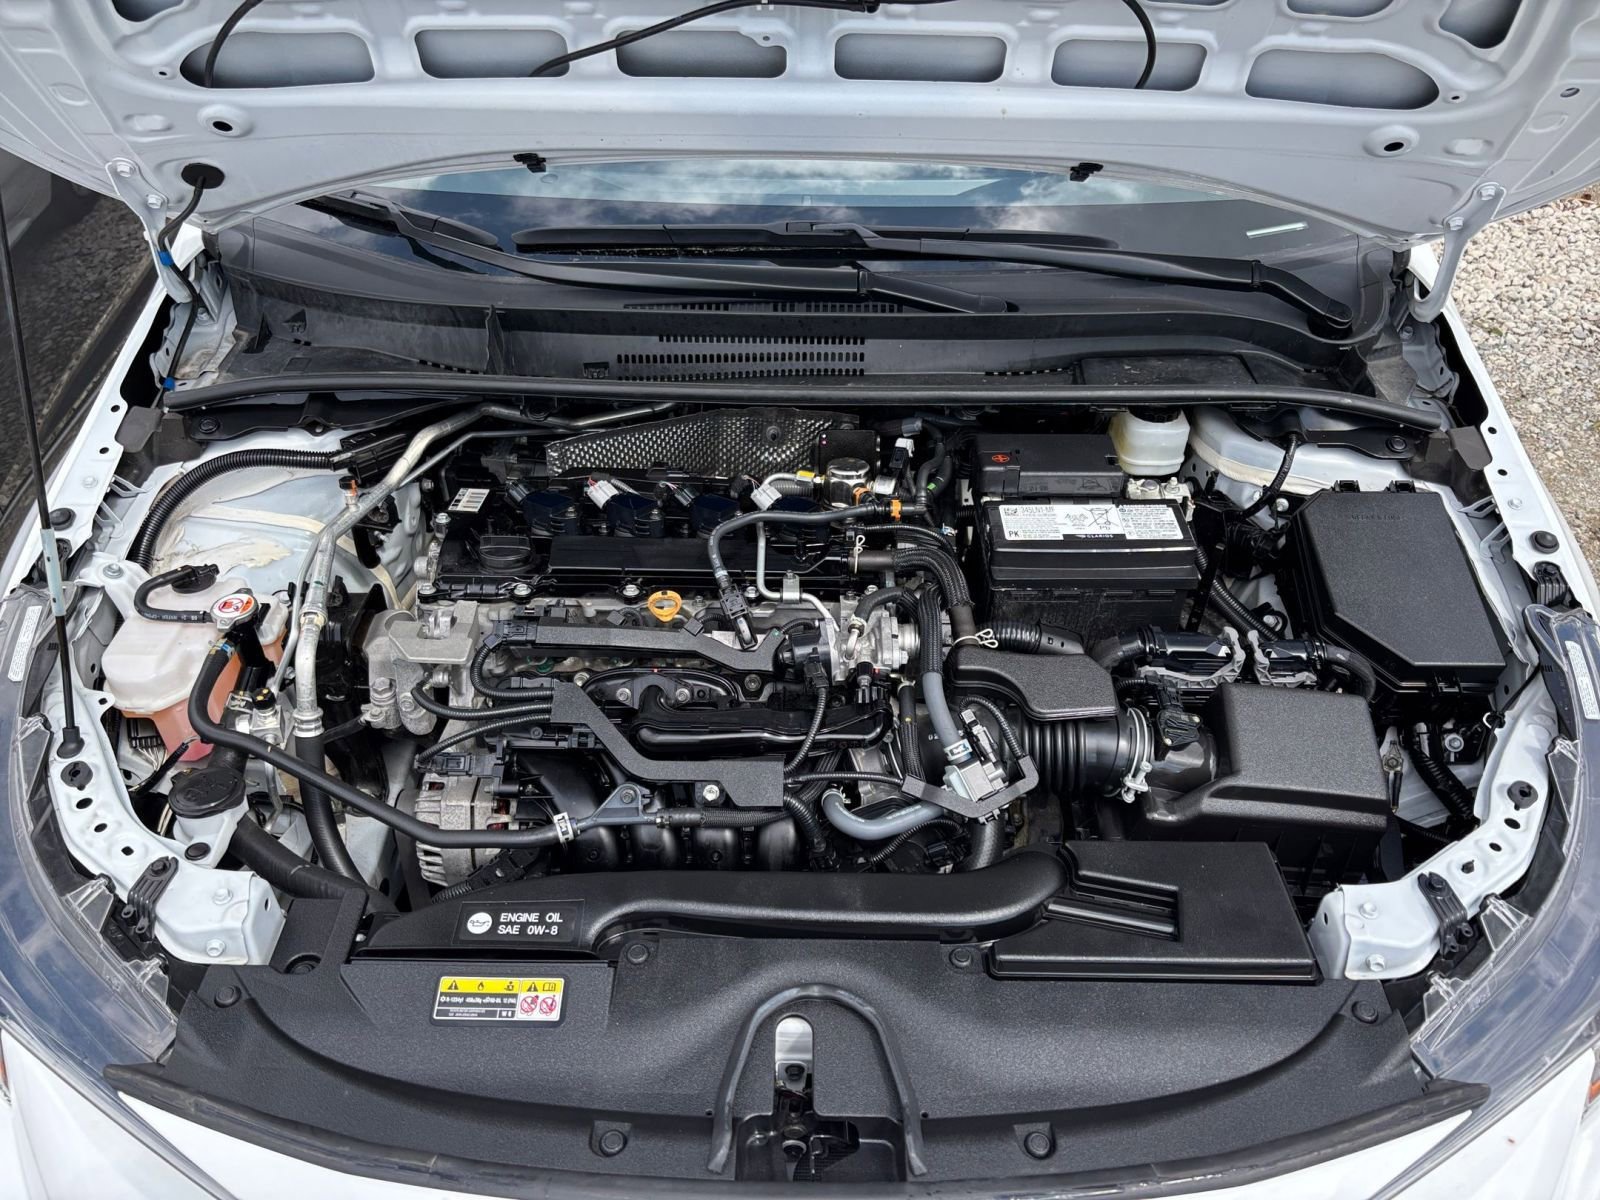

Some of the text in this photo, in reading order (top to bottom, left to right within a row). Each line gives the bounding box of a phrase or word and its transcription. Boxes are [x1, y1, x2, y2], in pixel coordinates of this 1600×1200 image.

[1008, 530, 1019, 538] PK
[499, 912, 563, 922] ENGINE OIL
[497, 925, 559, 935] SAE 0W-8
